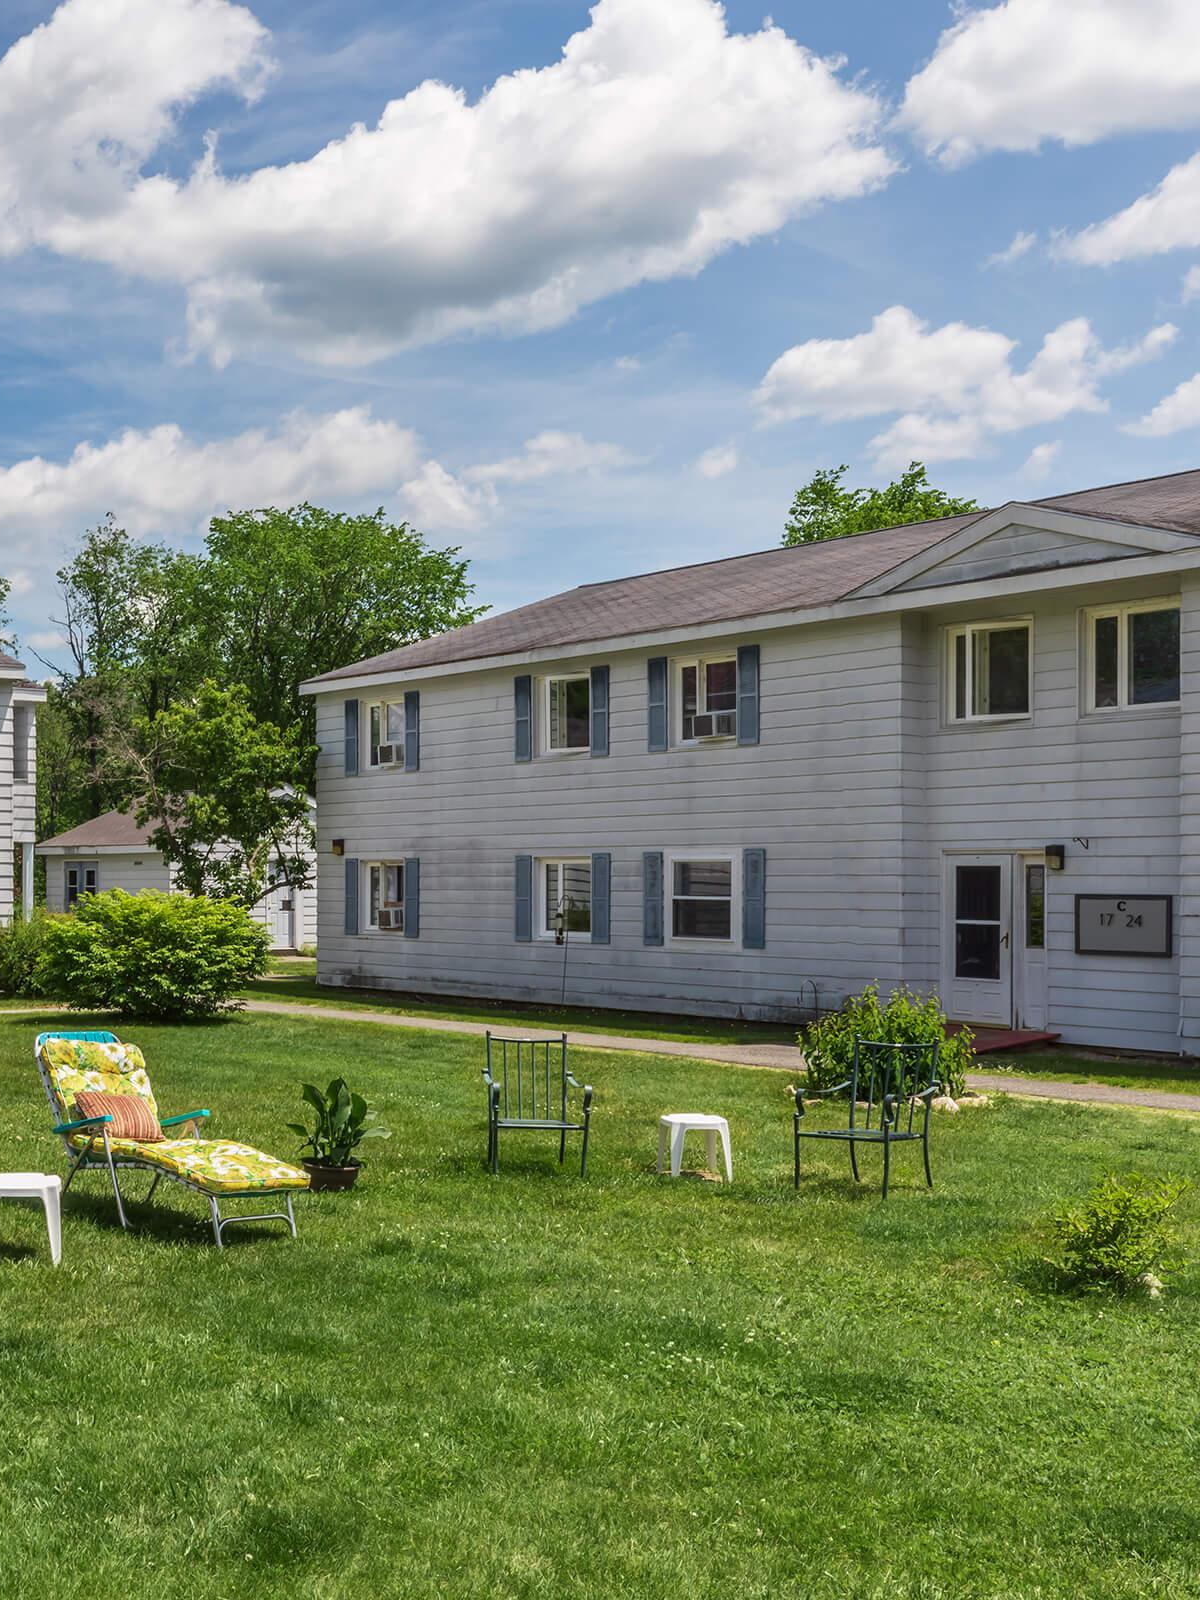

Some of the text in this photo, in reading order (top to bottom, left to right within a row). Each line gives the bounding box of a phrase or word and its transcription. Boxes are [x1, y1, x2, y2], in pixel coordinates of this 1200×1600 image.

[1117, 901, 1127, 912] C
[1099, 913, 1143, 928] 17 24
